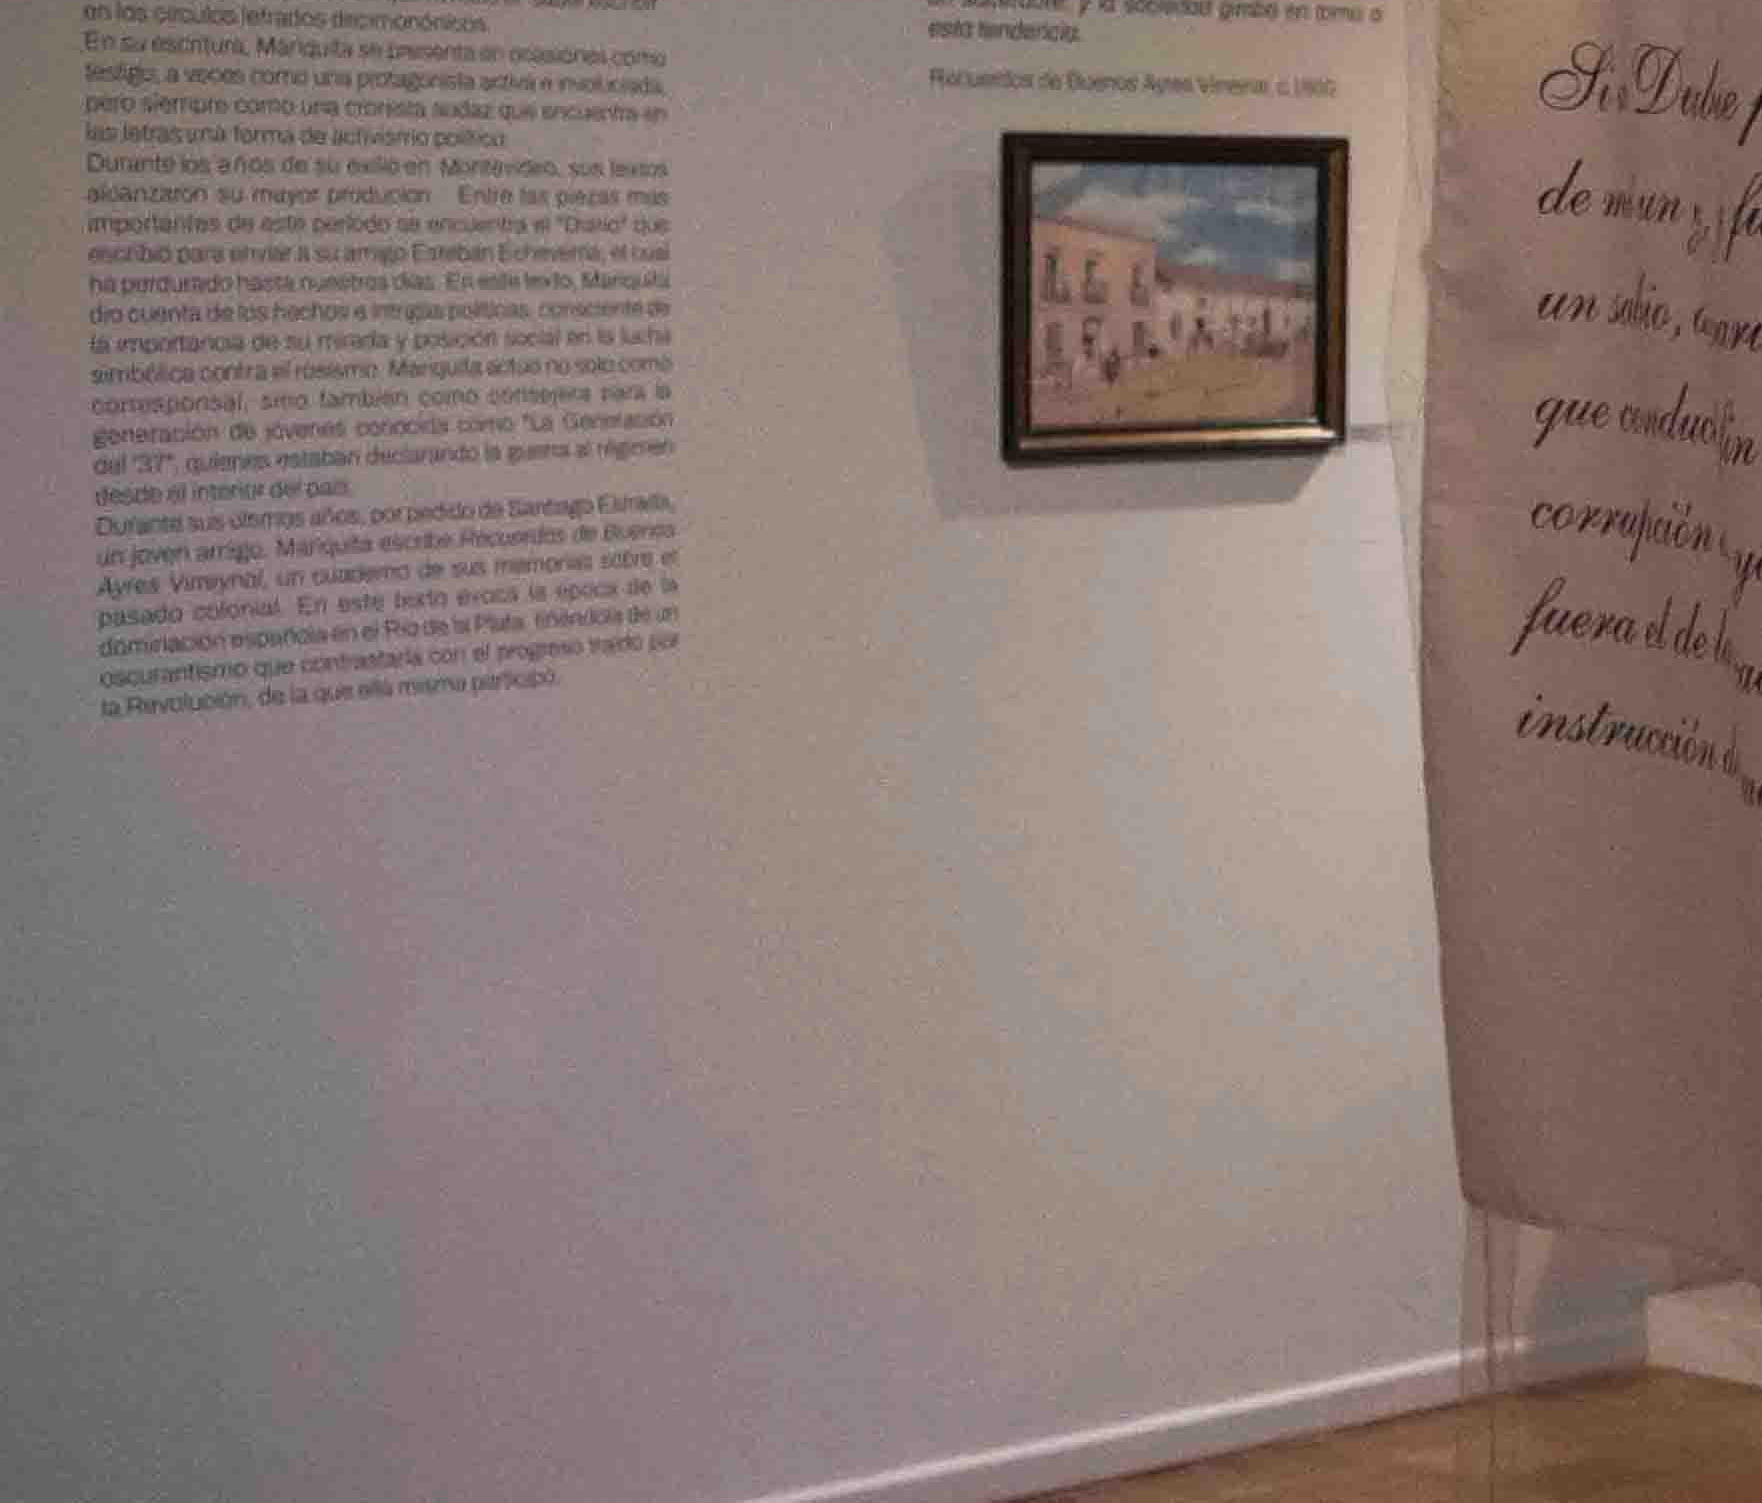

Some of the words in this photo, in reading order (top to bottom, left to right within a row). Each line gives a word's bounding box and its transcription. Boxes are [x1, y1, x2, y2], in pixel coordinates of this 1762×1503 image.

[1537, 159, 1592, 218] de
[1536, 289, 1600, 324] un
[1532, 394, 1611, 450] que
[1509, 576, 1638, 658] fuera
[1515, 691, 1718, 774] instrucción
